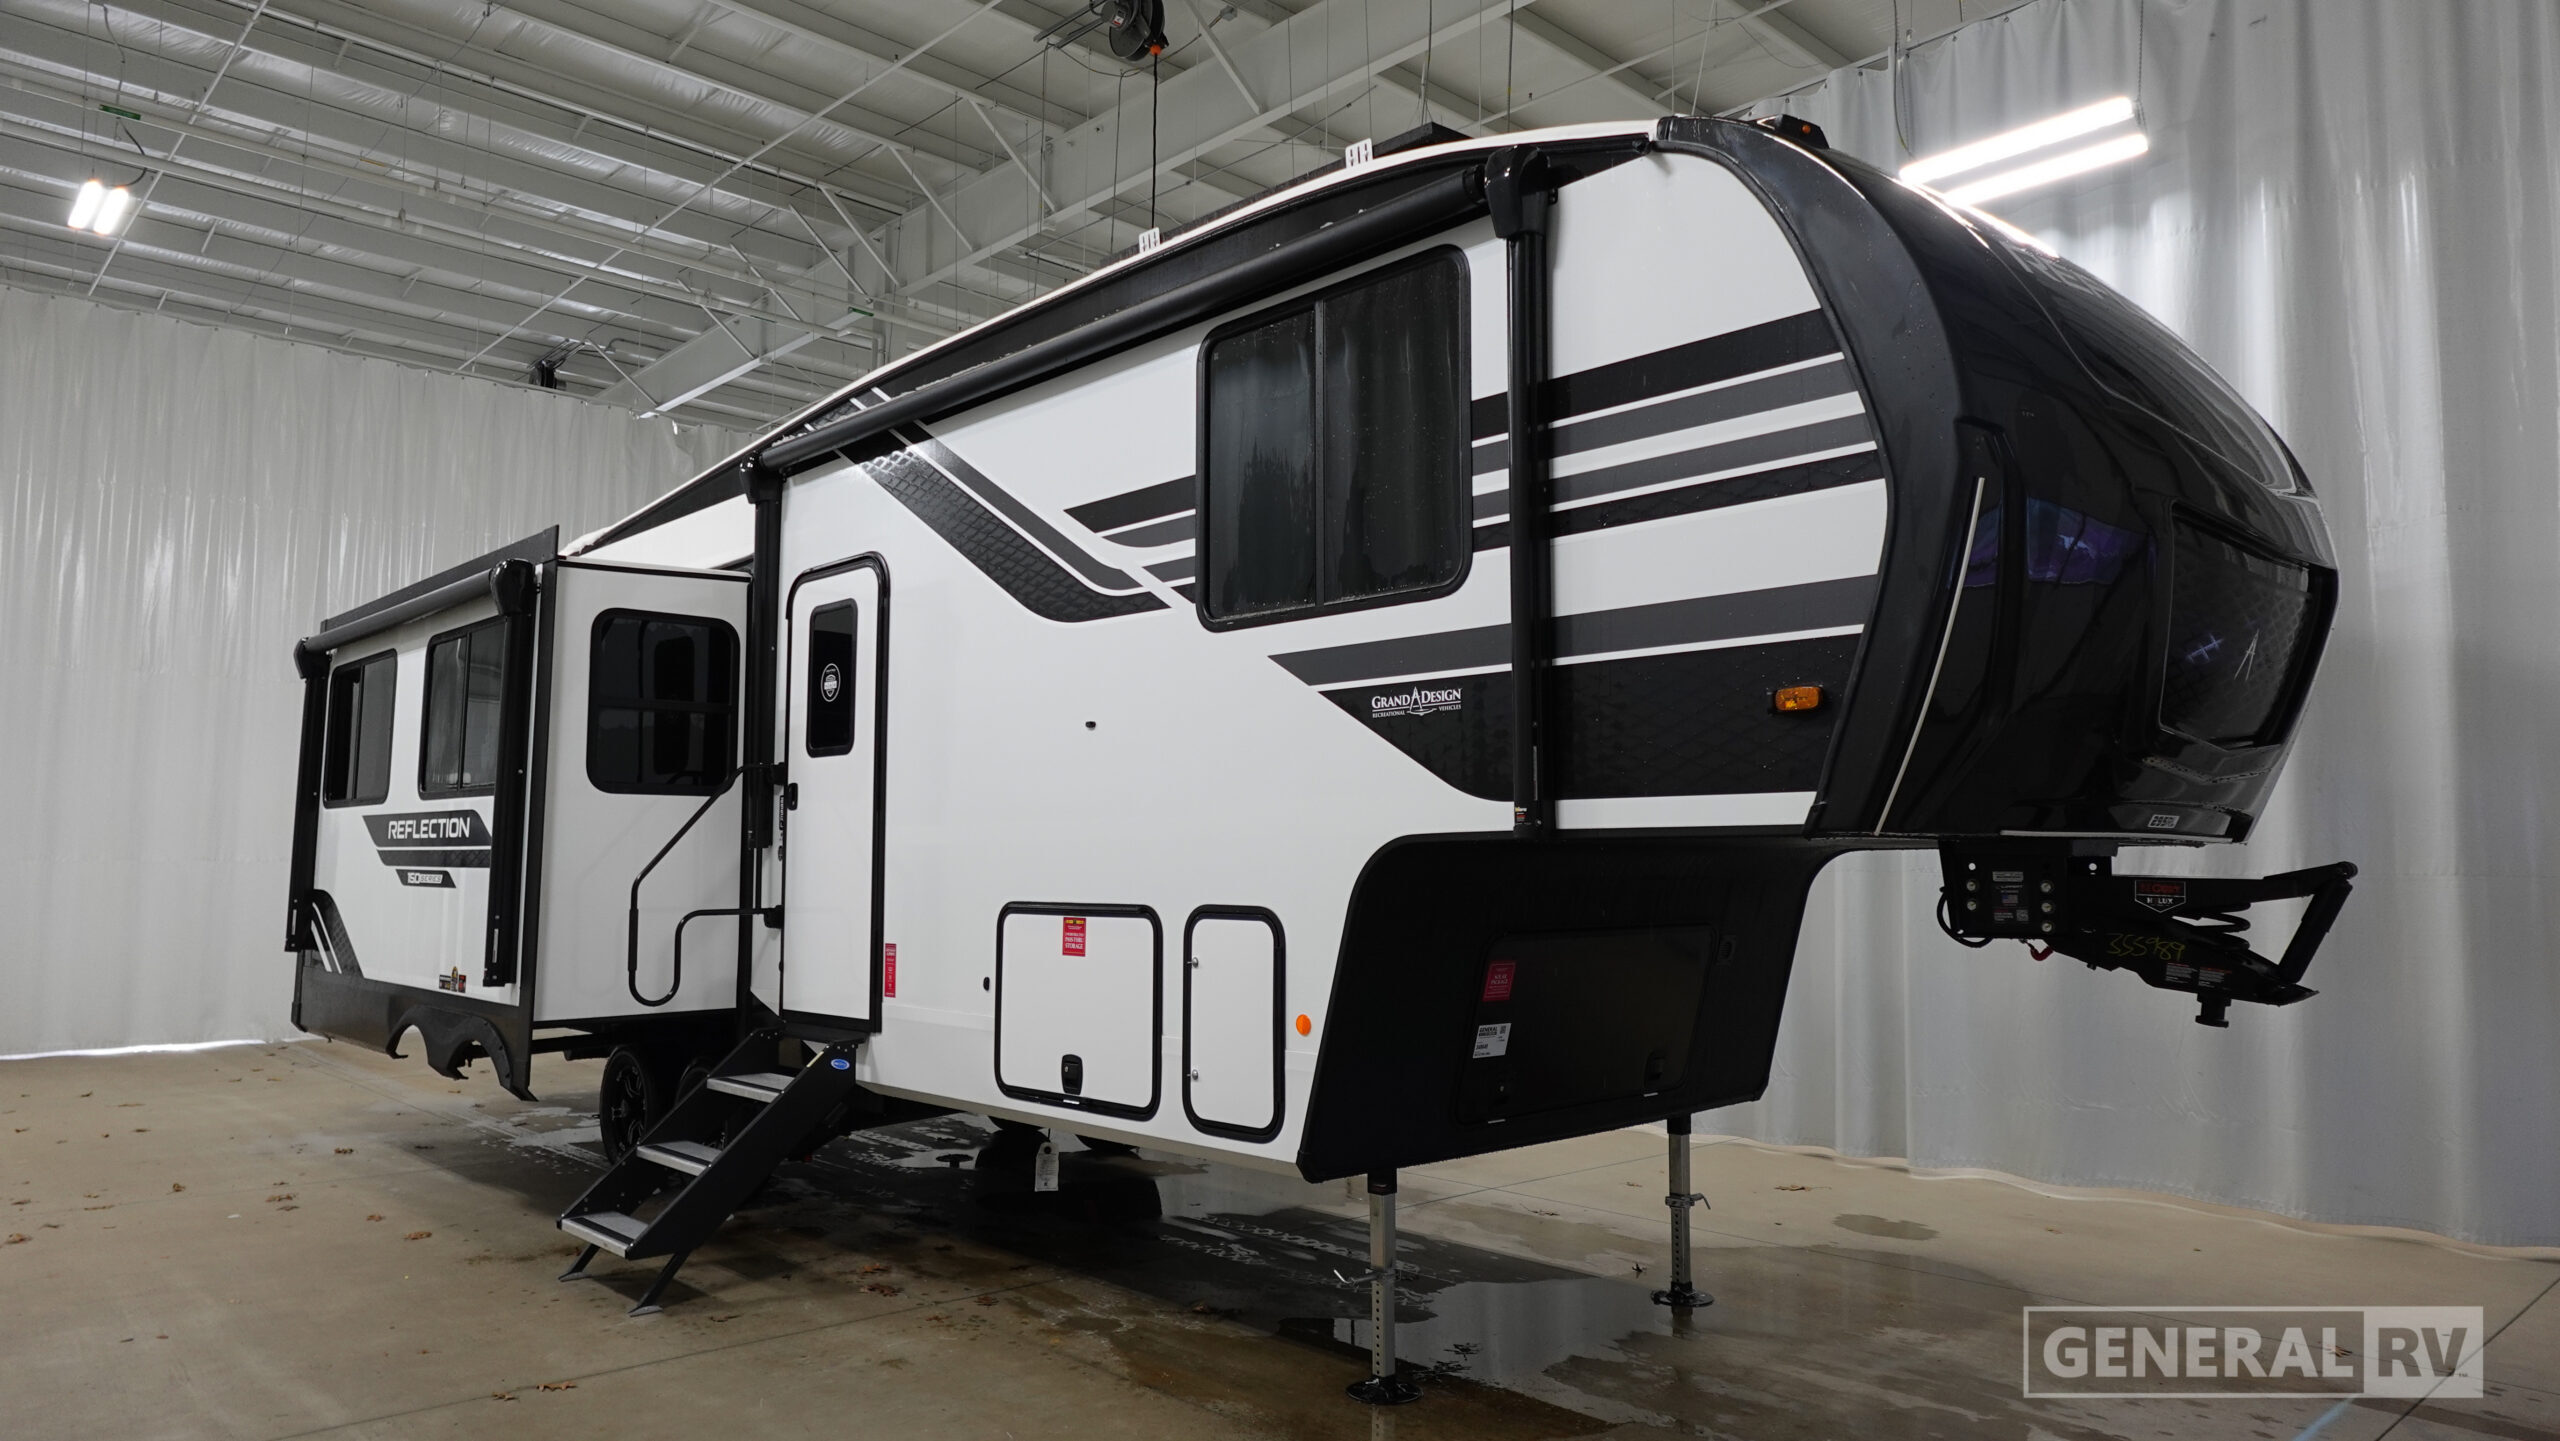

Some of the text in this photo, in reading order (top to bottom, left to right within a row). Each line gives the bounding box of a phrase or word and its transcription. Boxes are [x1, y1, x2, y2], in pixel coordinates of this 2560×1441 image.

[1371, 688, 1462, 709] GRAND DESIGN
[1372, 704, 1462, 718] RECREATIONAL VEHICLES
[388, 817, 471, 840] REFLECTION
